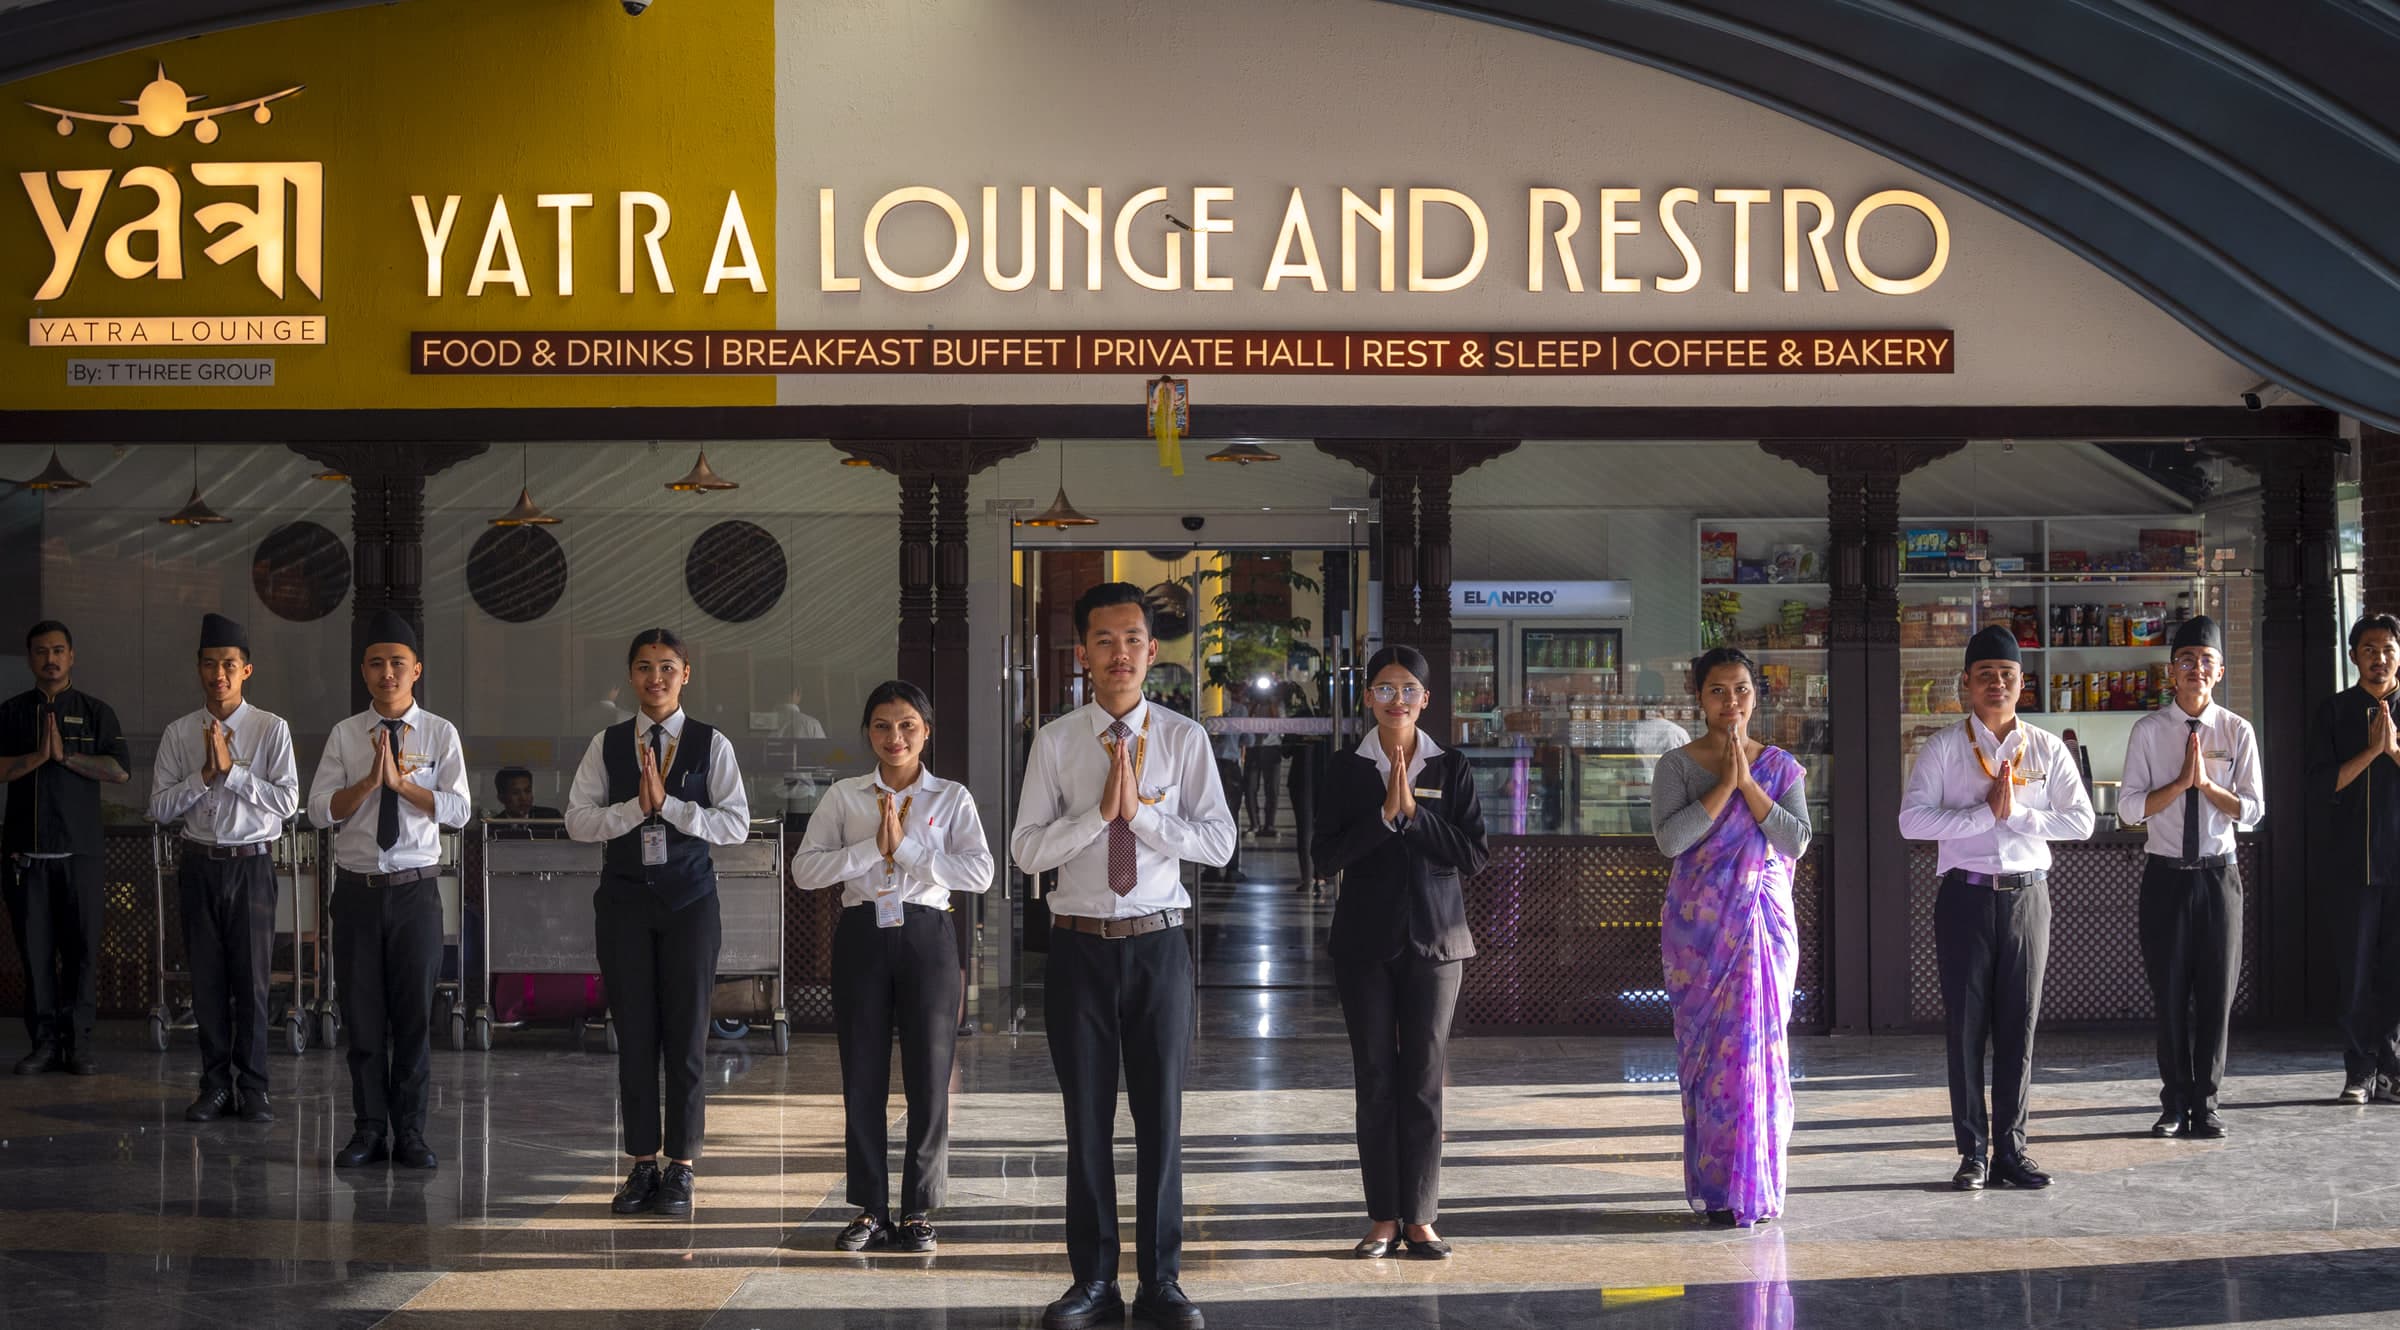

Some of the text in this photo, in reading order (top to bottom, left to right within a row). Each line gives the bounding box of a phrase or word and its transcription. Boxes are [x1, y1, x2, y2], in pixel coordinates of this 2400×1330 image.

[411, 186, 1951, 297] YATRA LOUNGE AND RESTRO
[40, 320, 316, 342] YATRA LOUNGE
[423, 338, 1949, 368] FOOD & DRINKS BREAKFAST BUFFET PRIVATE HALL REST & SLEEP COFFEE & BAKERY
[73, 364, 269, 384] By: T THREE GROUP
